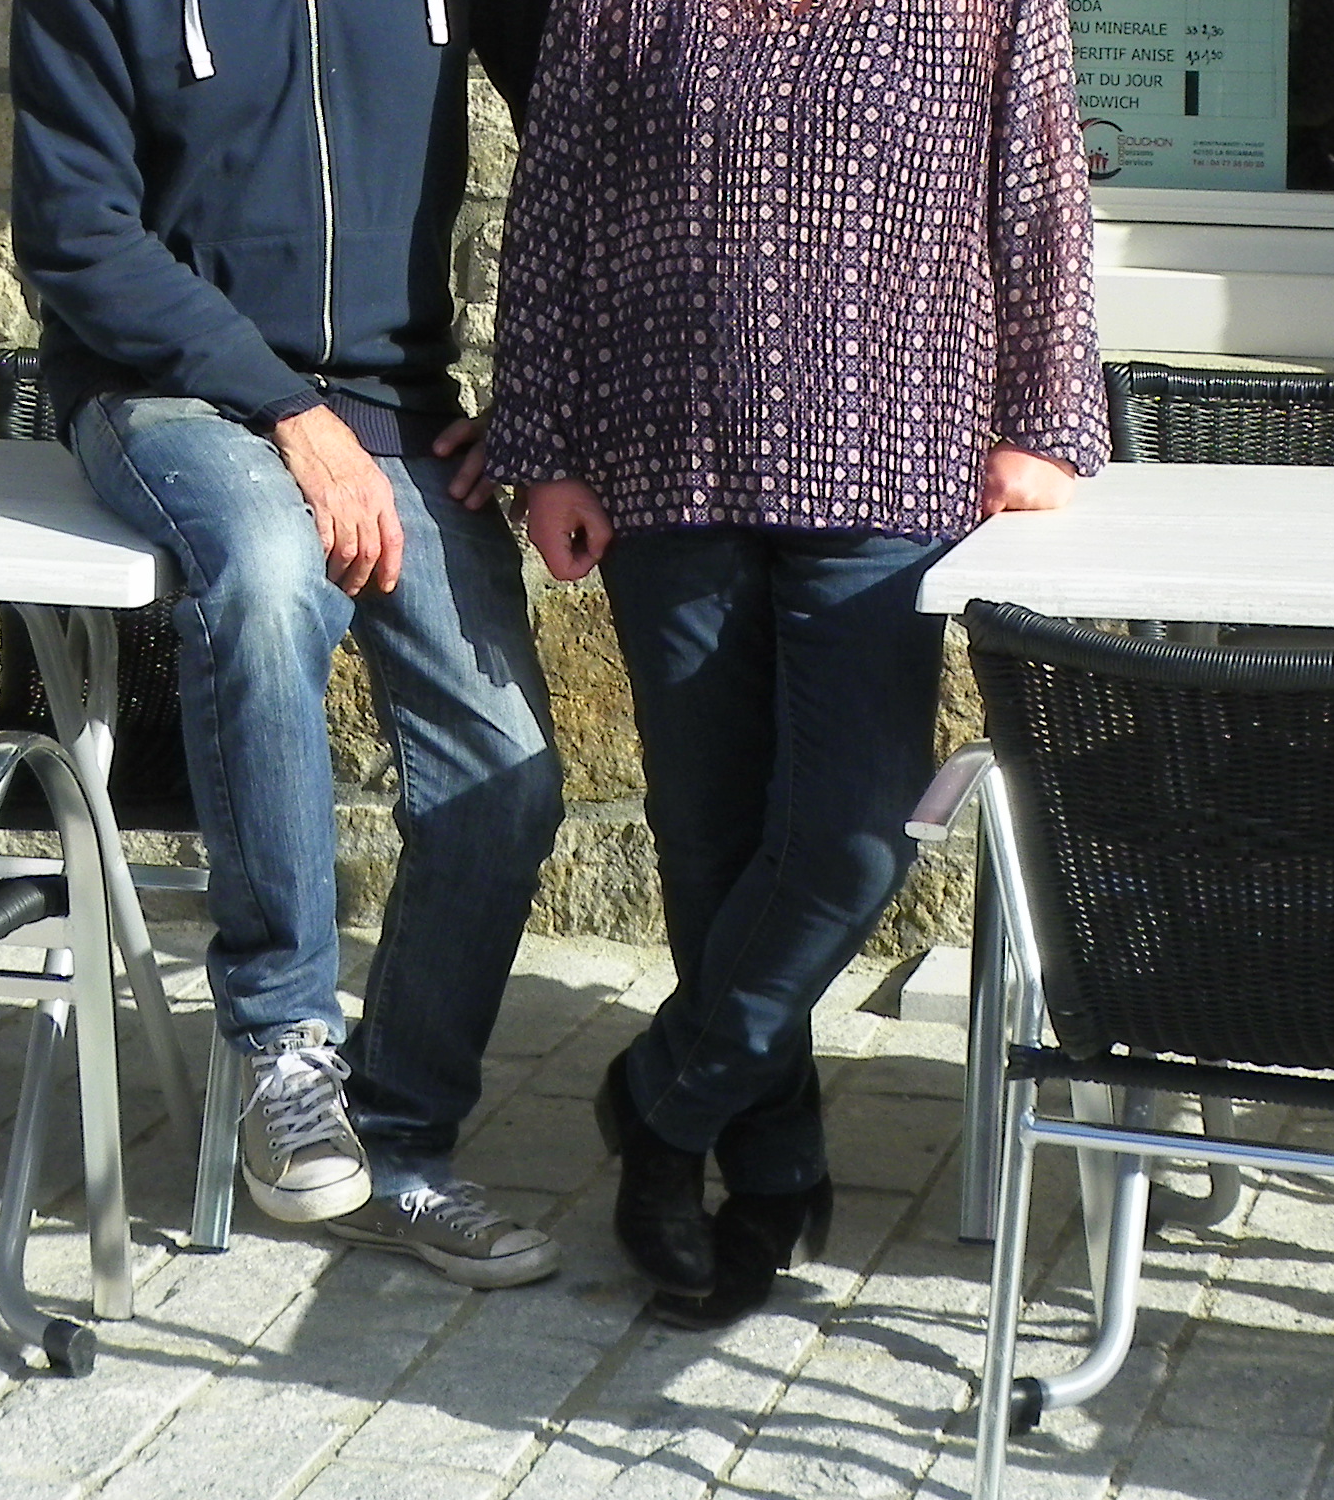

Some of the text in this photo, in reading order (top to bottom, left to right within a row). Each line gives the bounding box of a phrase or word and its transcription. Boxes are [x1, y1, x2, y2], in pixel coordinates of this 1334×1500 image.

[1095, 22, 1168, 36] MINERALE
[1073, 47, 1174, 62] PERITIF ANISE
[1100, 74, 1120, 86] DU
[1126, 74, 1163, 87] JOUR
[1079, 95, 1140, 109] NDWICH
